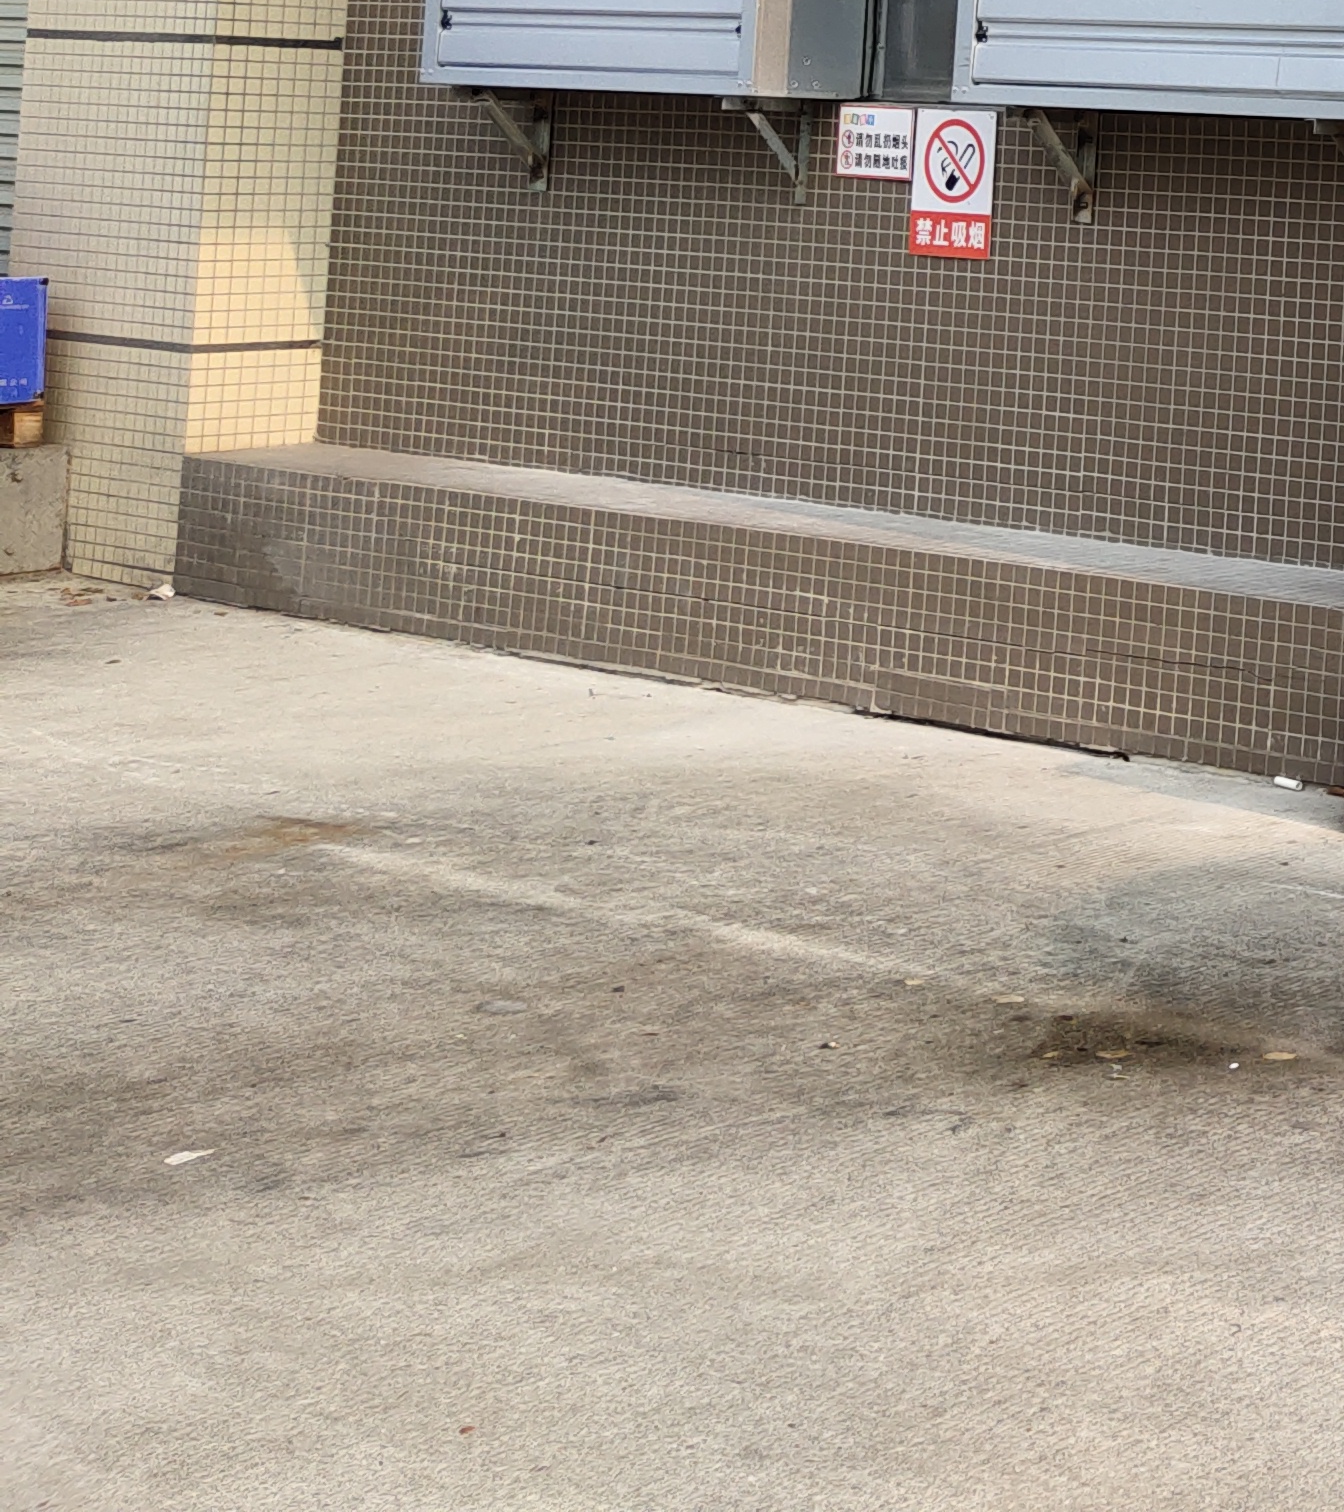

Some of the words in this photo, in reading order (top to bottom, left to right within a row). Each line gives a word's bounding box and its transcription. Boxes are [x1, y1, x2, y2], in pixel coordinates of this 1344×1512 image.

[855, 132, 909, 150] 请勿乱扔烟头
[915, 217, 986, 250] 禁止吸烟
